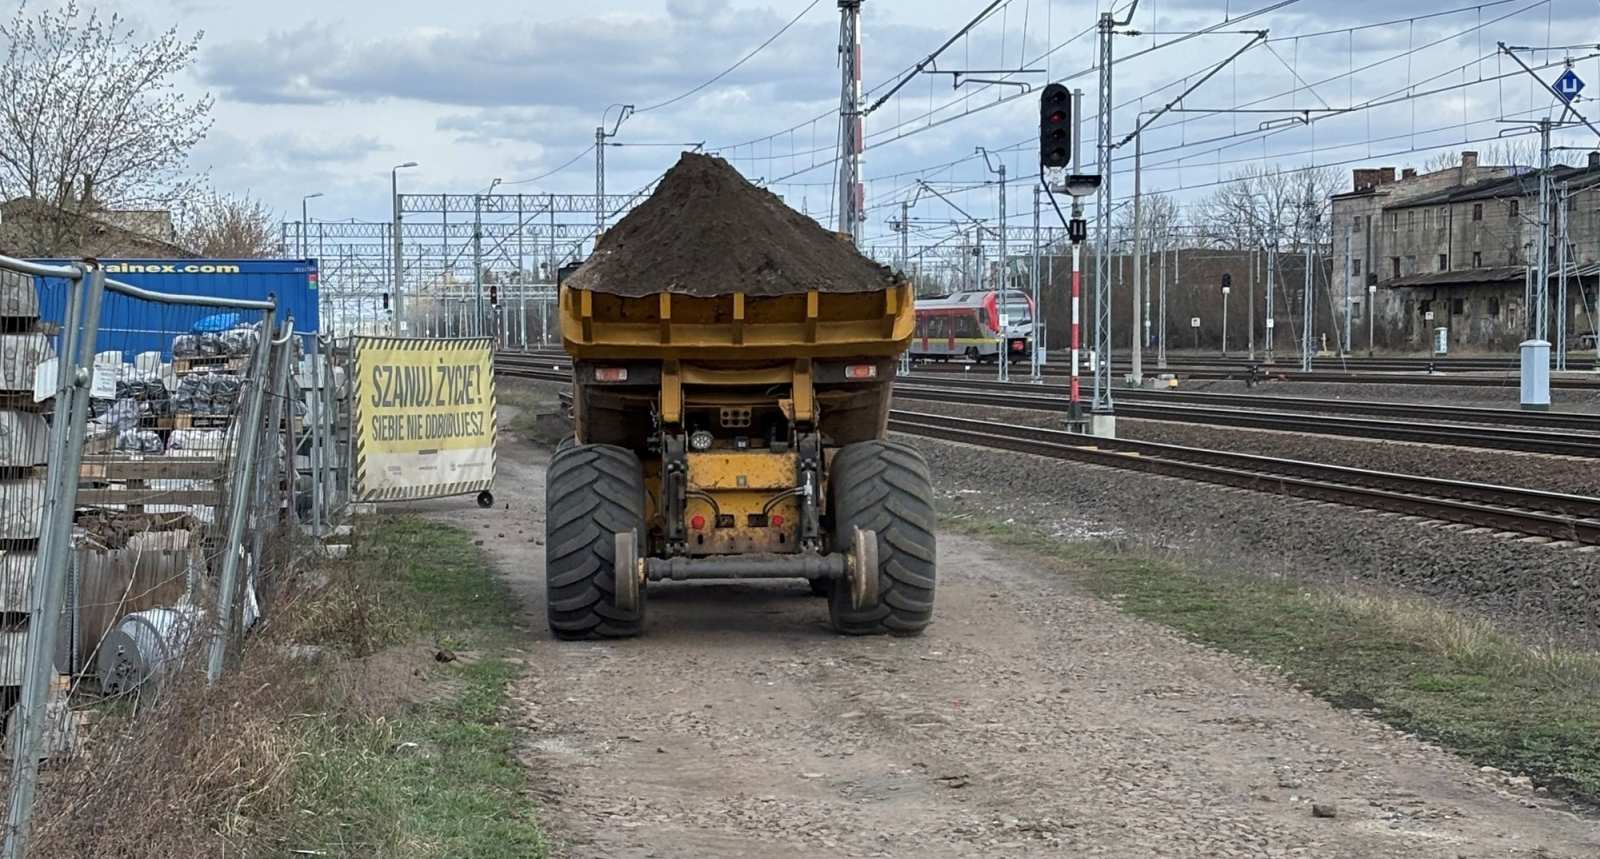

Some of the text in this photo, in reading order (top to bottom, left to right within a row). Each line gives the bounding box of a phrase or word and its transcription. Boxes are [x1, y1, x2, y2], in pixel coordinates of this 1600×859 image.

[372, 357, 482, 408] SZANUJ ŻYCIE!
[371, 414, 405, 441] SIEBIE
[406, 414, 423, 440] NIE
